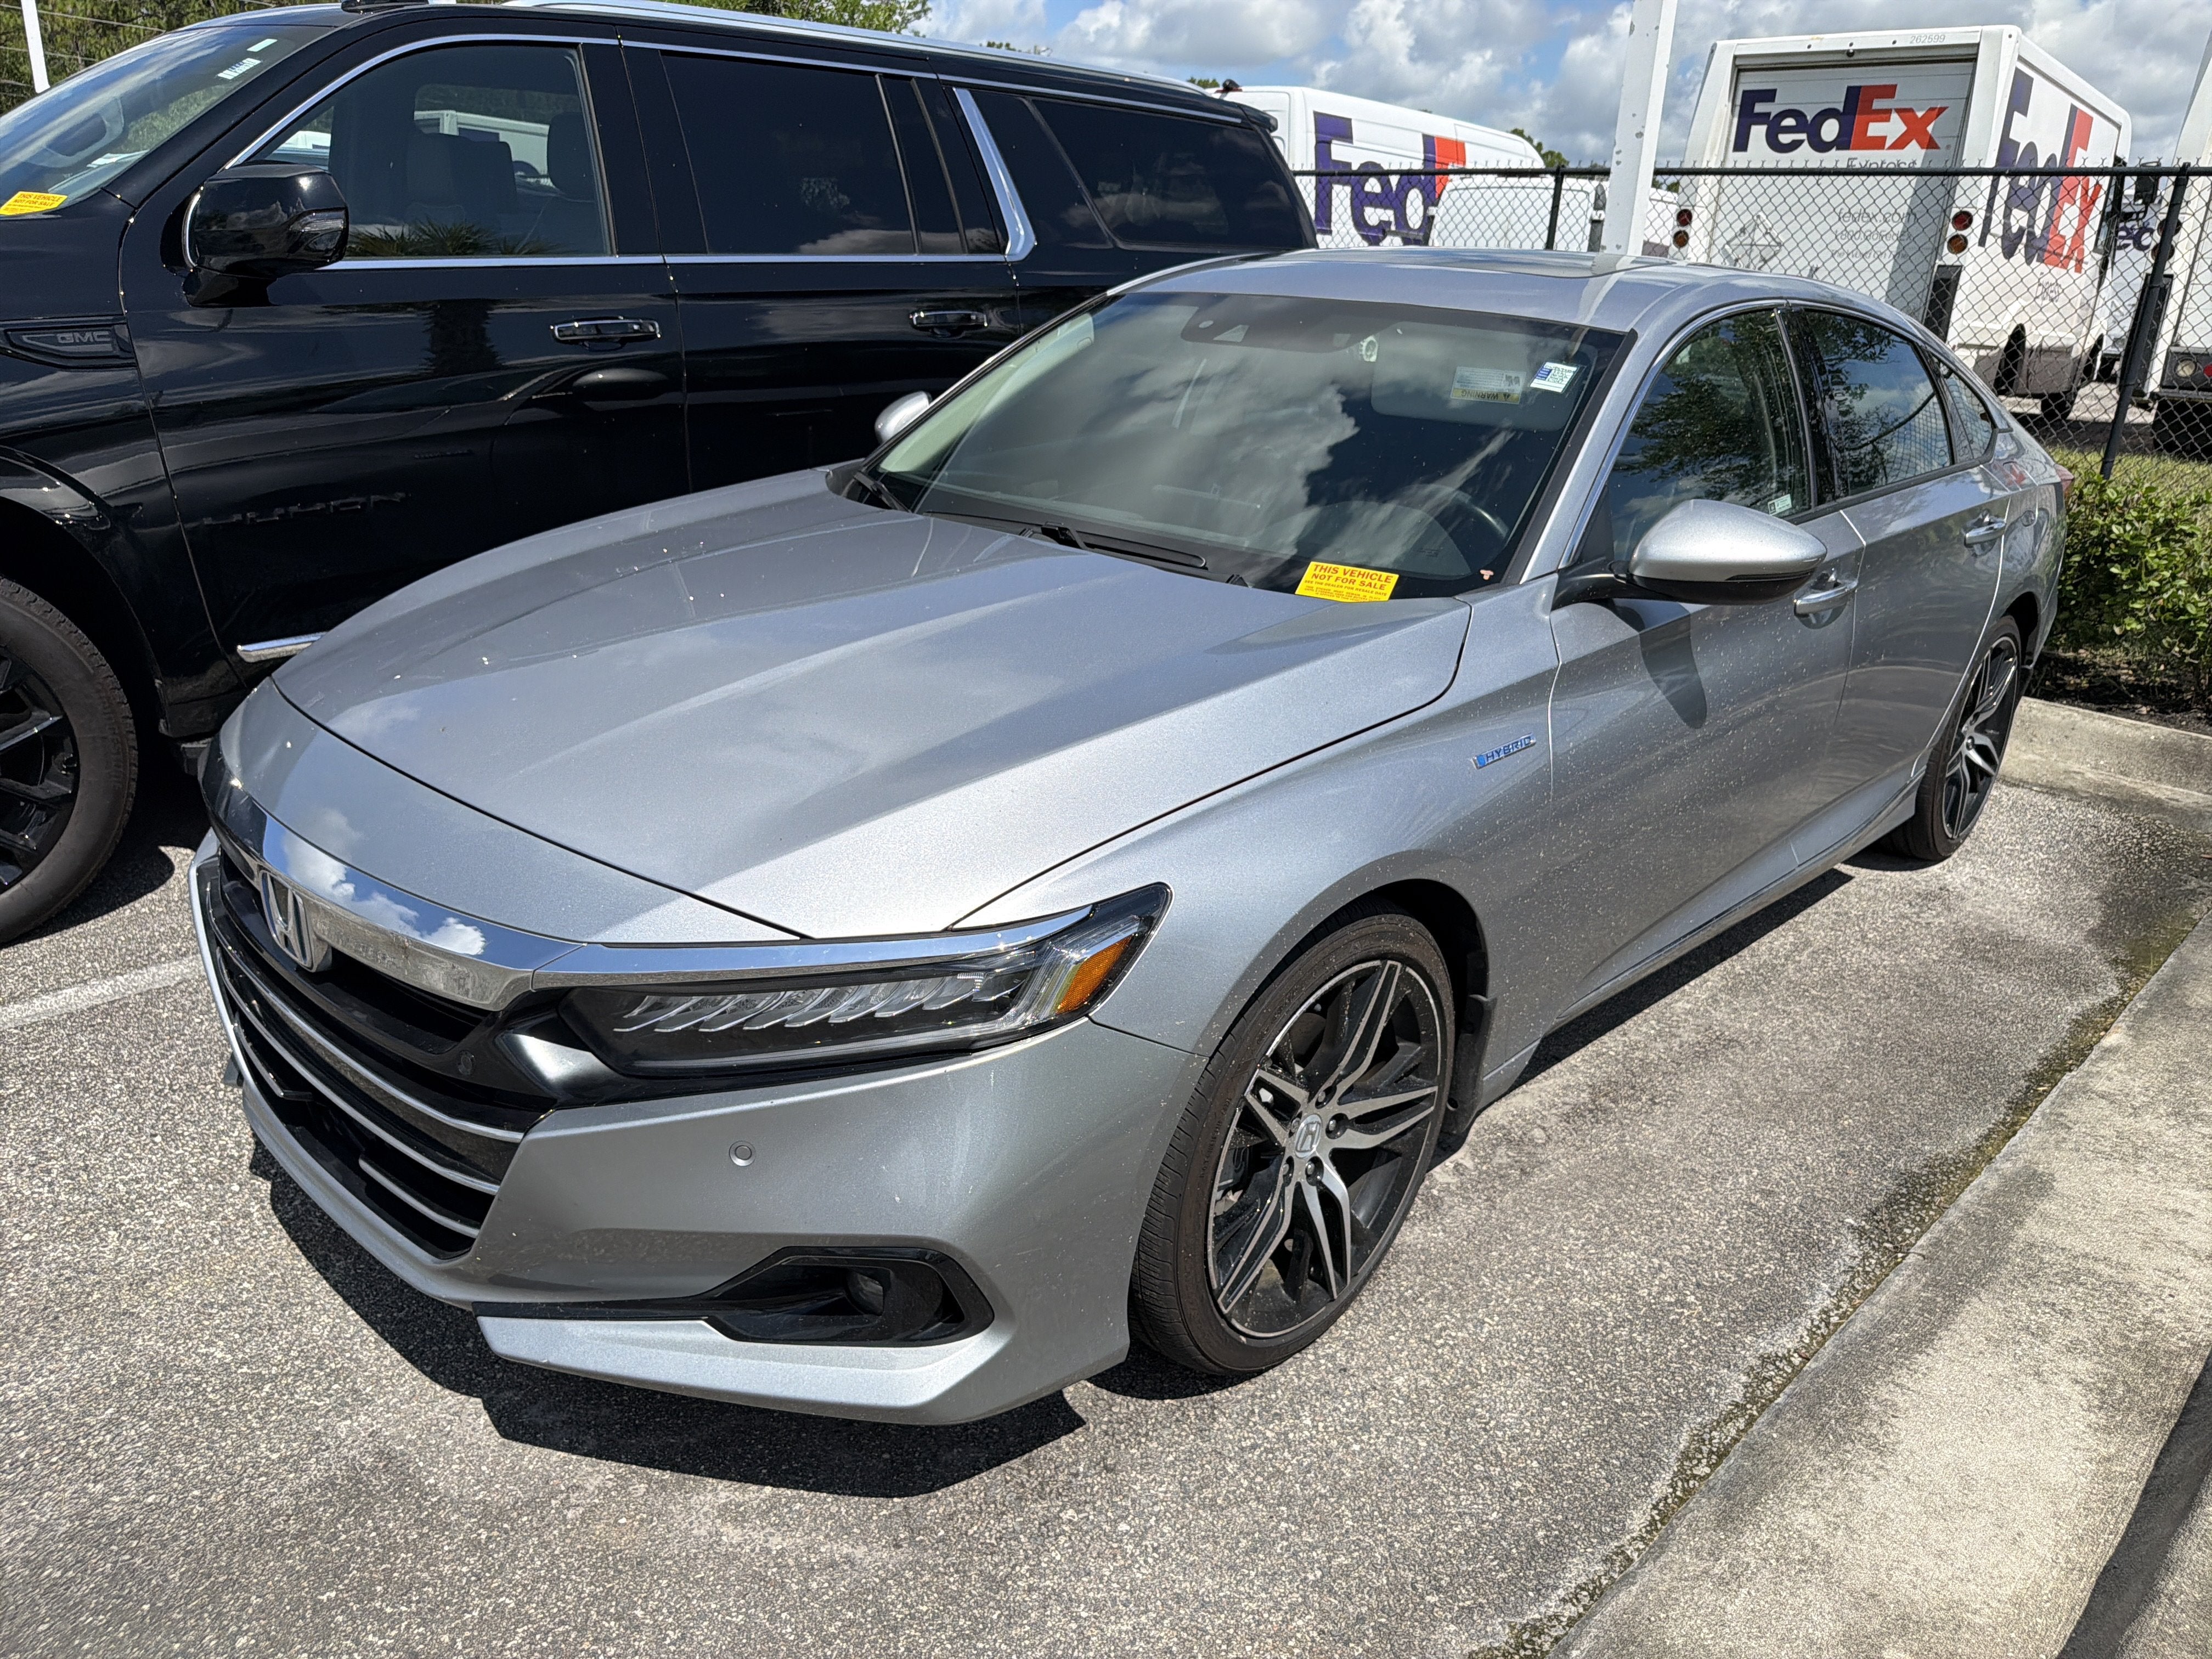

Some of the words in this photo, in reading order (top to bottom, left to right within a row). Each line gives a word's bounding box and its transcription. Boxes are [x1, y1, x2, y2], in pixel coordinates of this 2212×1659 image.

[1909, 34, 1945, 44] 262599
[1733, 84, 1949, 153] FedEx
[1313, 111, 1465, 245] Fed
[1978, 66, 2102, 273] FedEx
[56, 331, 110, 343] GMC
[1460, 390, 1499, 401] WARNING
[1312, 573, 1333, 582] NOT
[1335, 577, 1357, 585] FOR
[1359, 580, 1386, 591] SALE
[1313, 565, 1339, 574] THIS
[1344, 568, 1393, 583] VEHICLE
[1486, 736, 1531, 761] HYBRID
